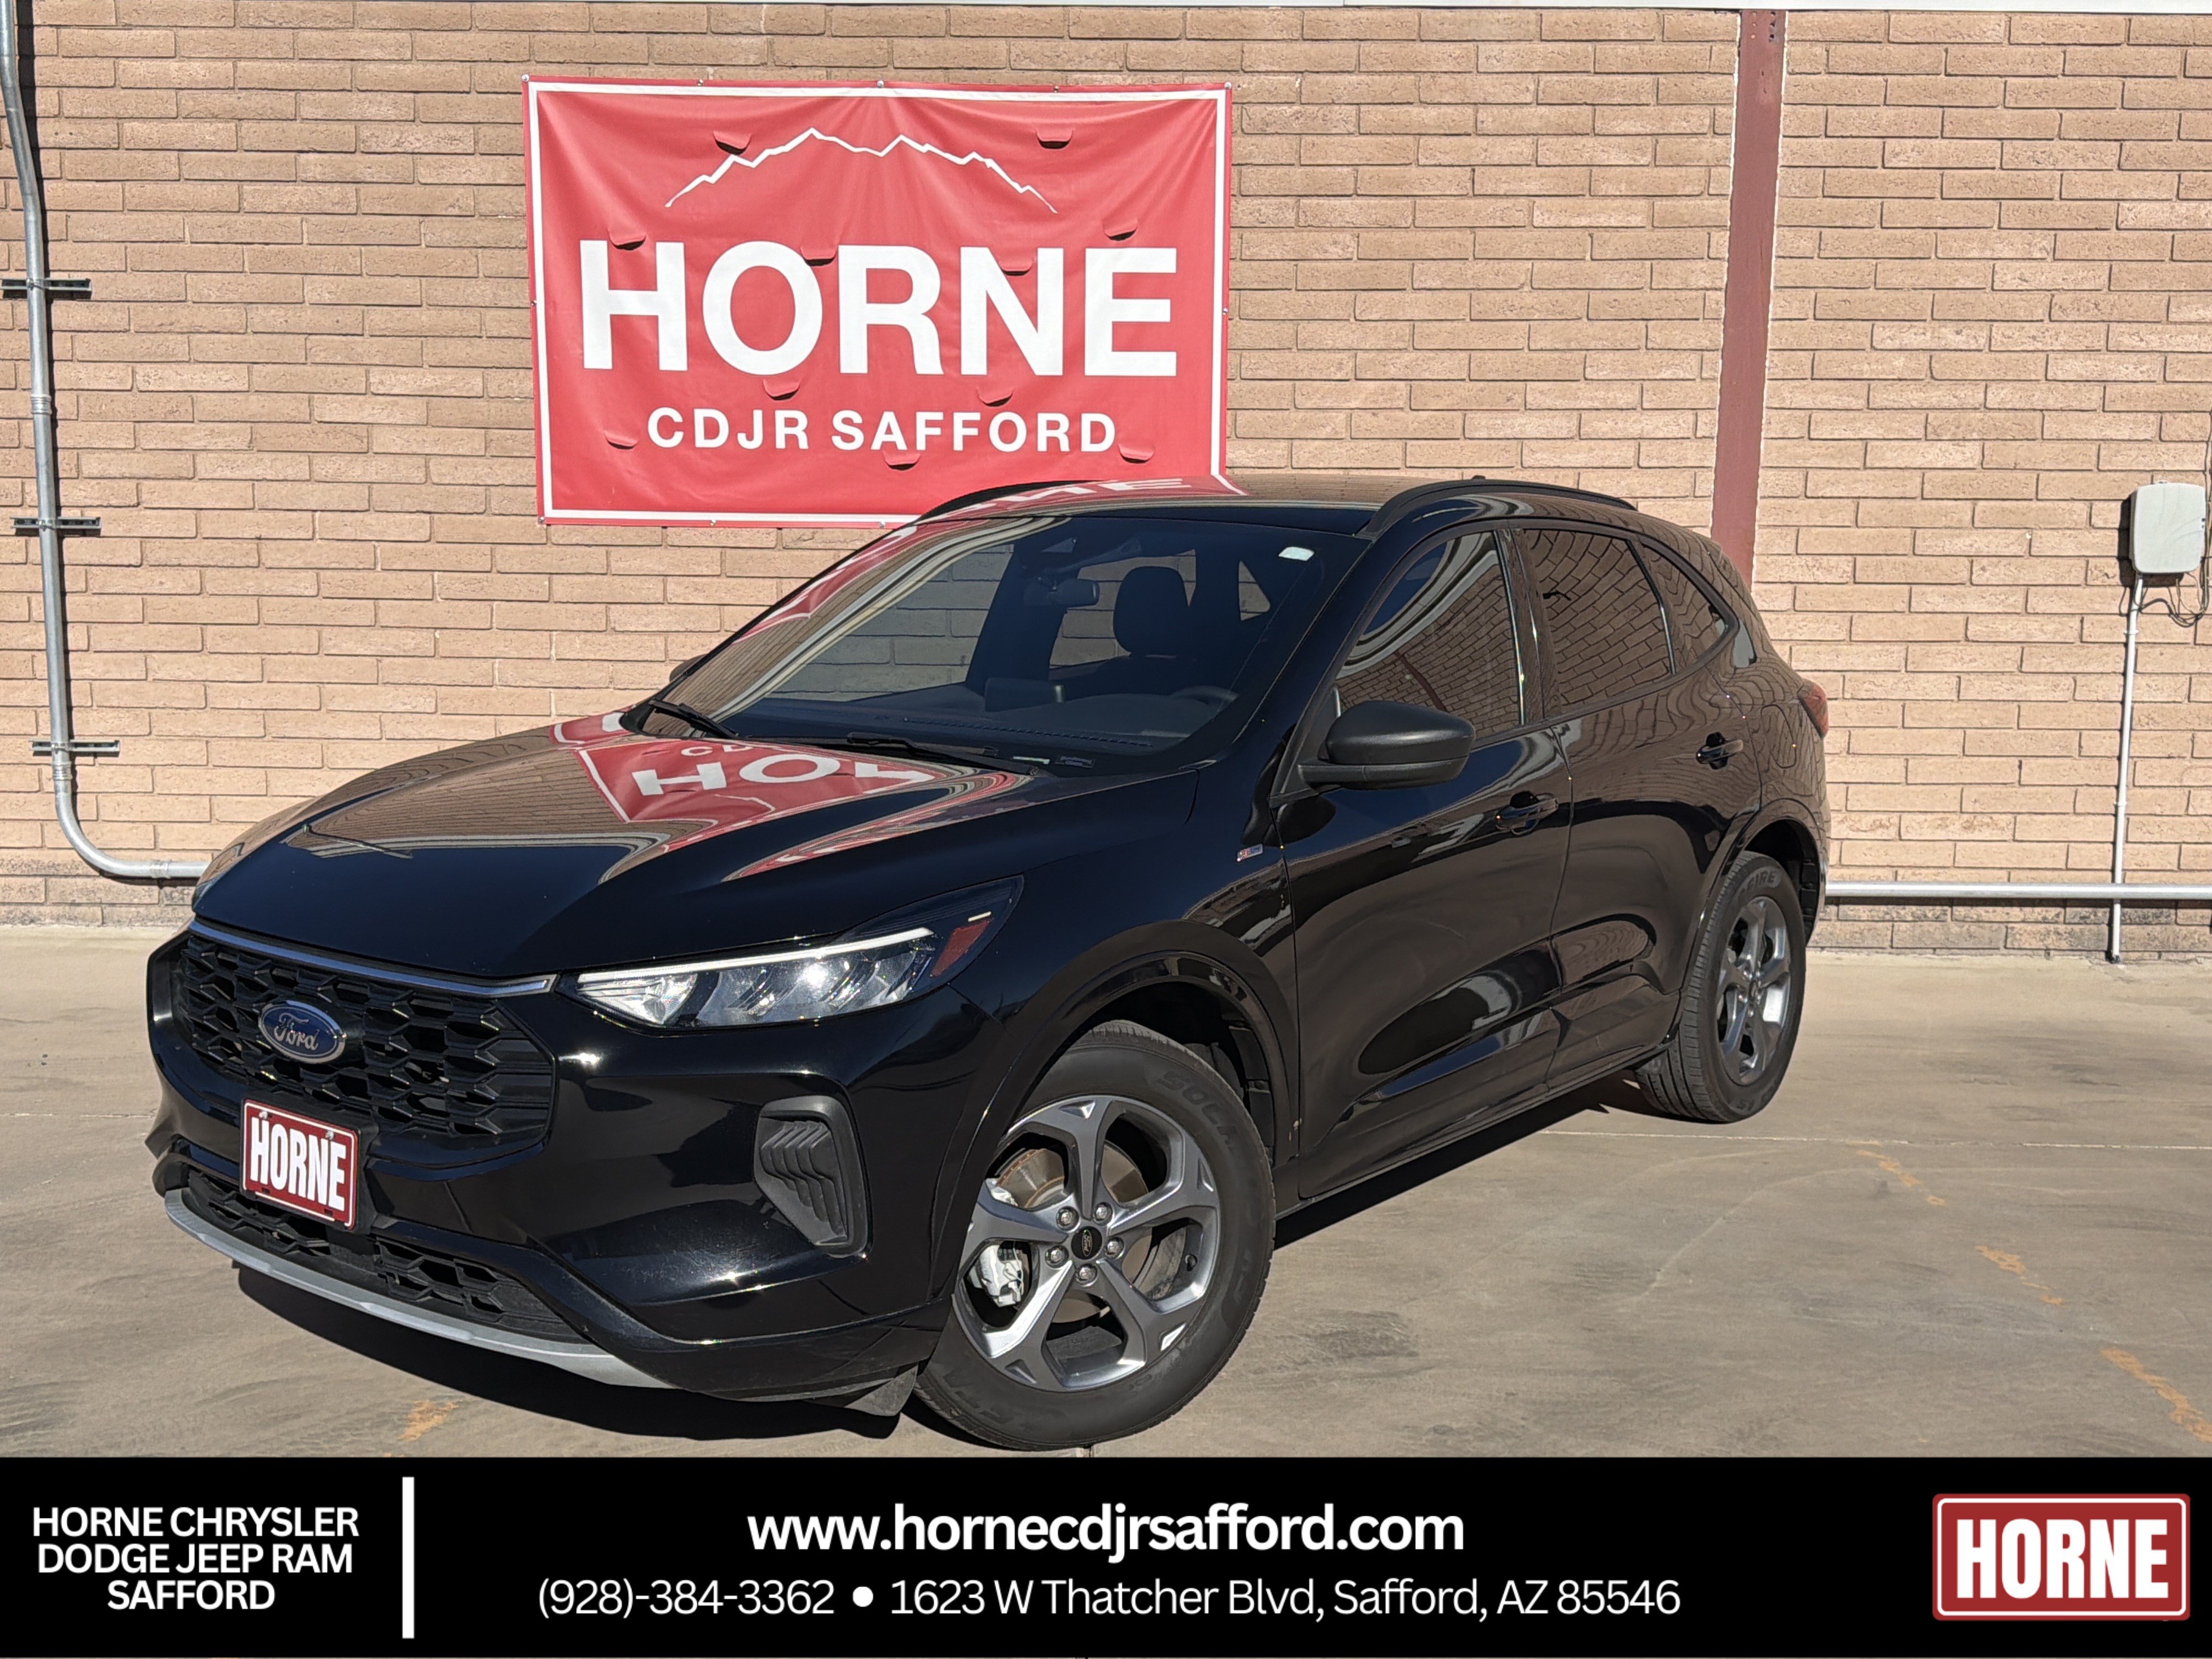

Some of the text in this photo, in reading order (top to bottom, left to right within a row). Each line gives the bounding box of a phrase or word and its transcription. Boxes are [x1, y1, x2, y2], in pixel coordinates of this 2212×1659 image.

[580, 240, 1177, 377] HORNE
[648, 407, 1116, 453] CDJR SAFFORD
[274, 1012, 320, 1051] Ford
[250, 1116, 346, 1212] HORNE
